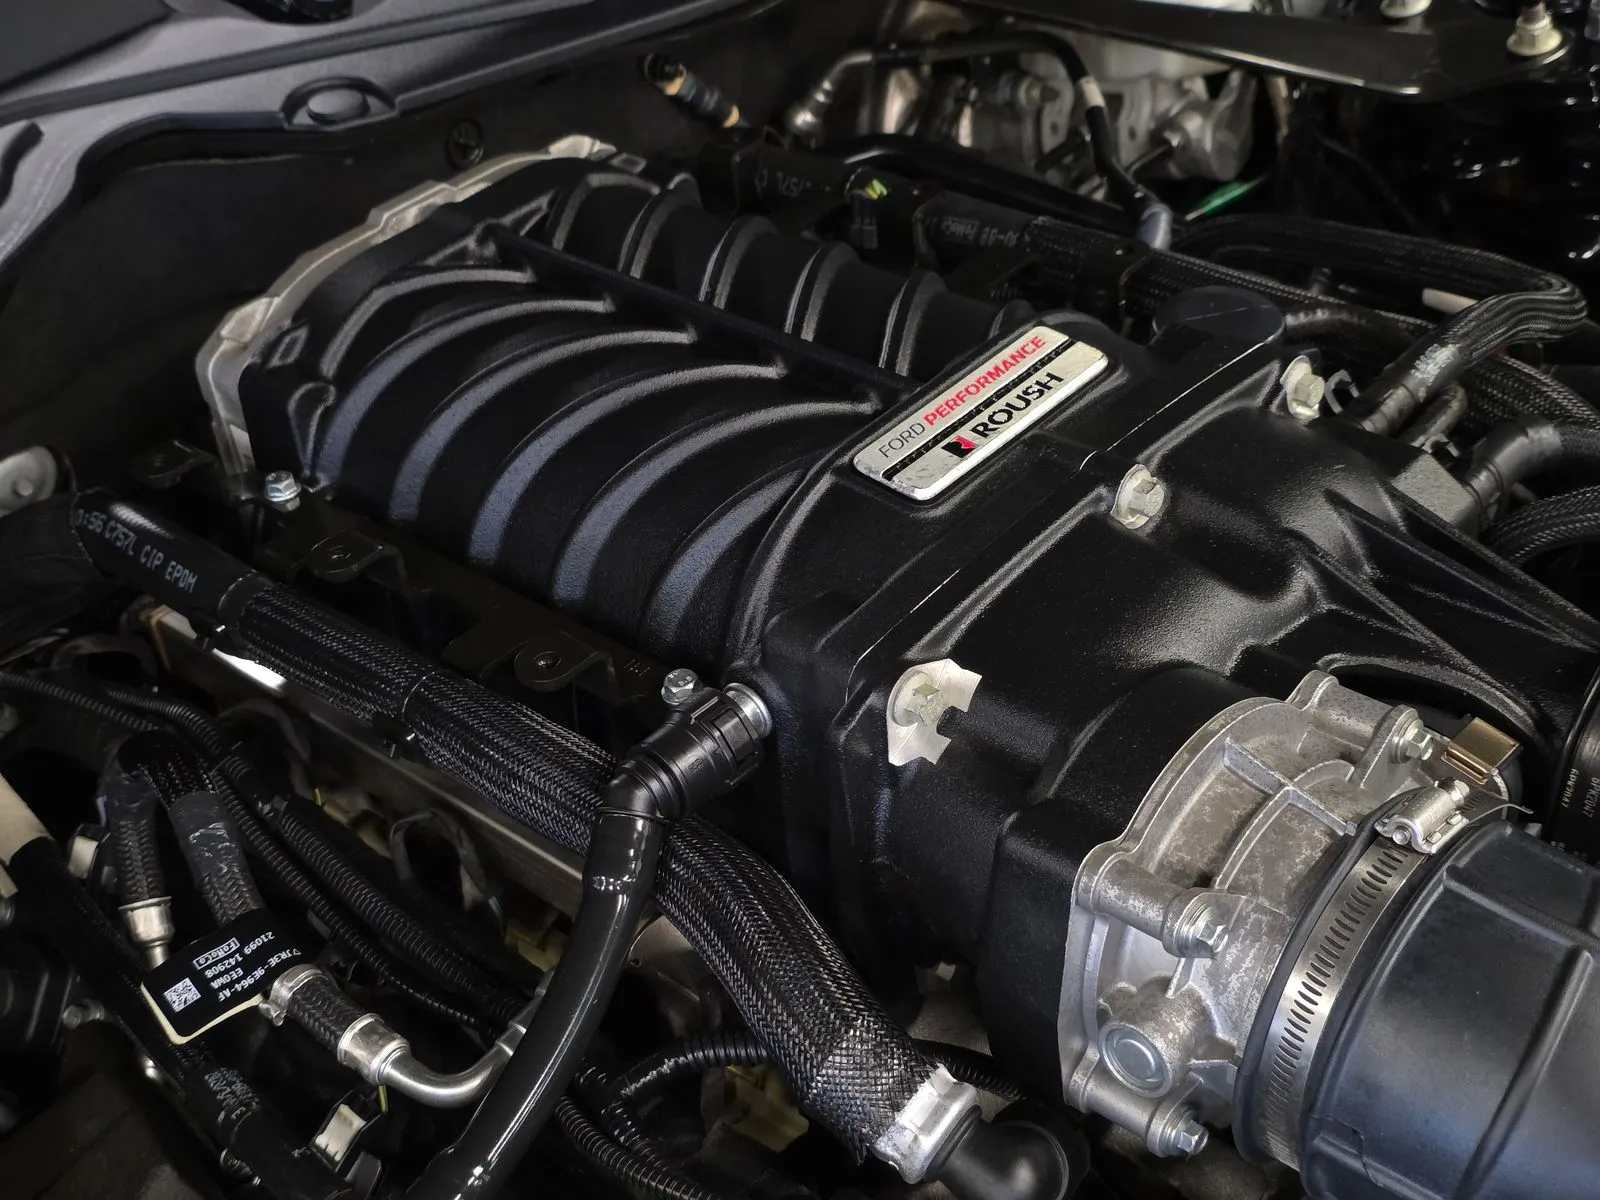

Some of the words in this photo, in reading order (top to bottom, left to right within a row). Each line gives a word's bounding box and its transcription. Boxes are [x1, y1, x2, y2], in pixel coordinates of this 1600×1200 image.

[878, 422, 926, 459] FORD
[922, 335, 1047, 427] PERFORMANCE
[969, 371, 1065, 439] ROUSH
[198, 939, 239, 967] FoMoCo
[243, 931, 276, 956] 21099
[204, 952, 244, 980] 142908
